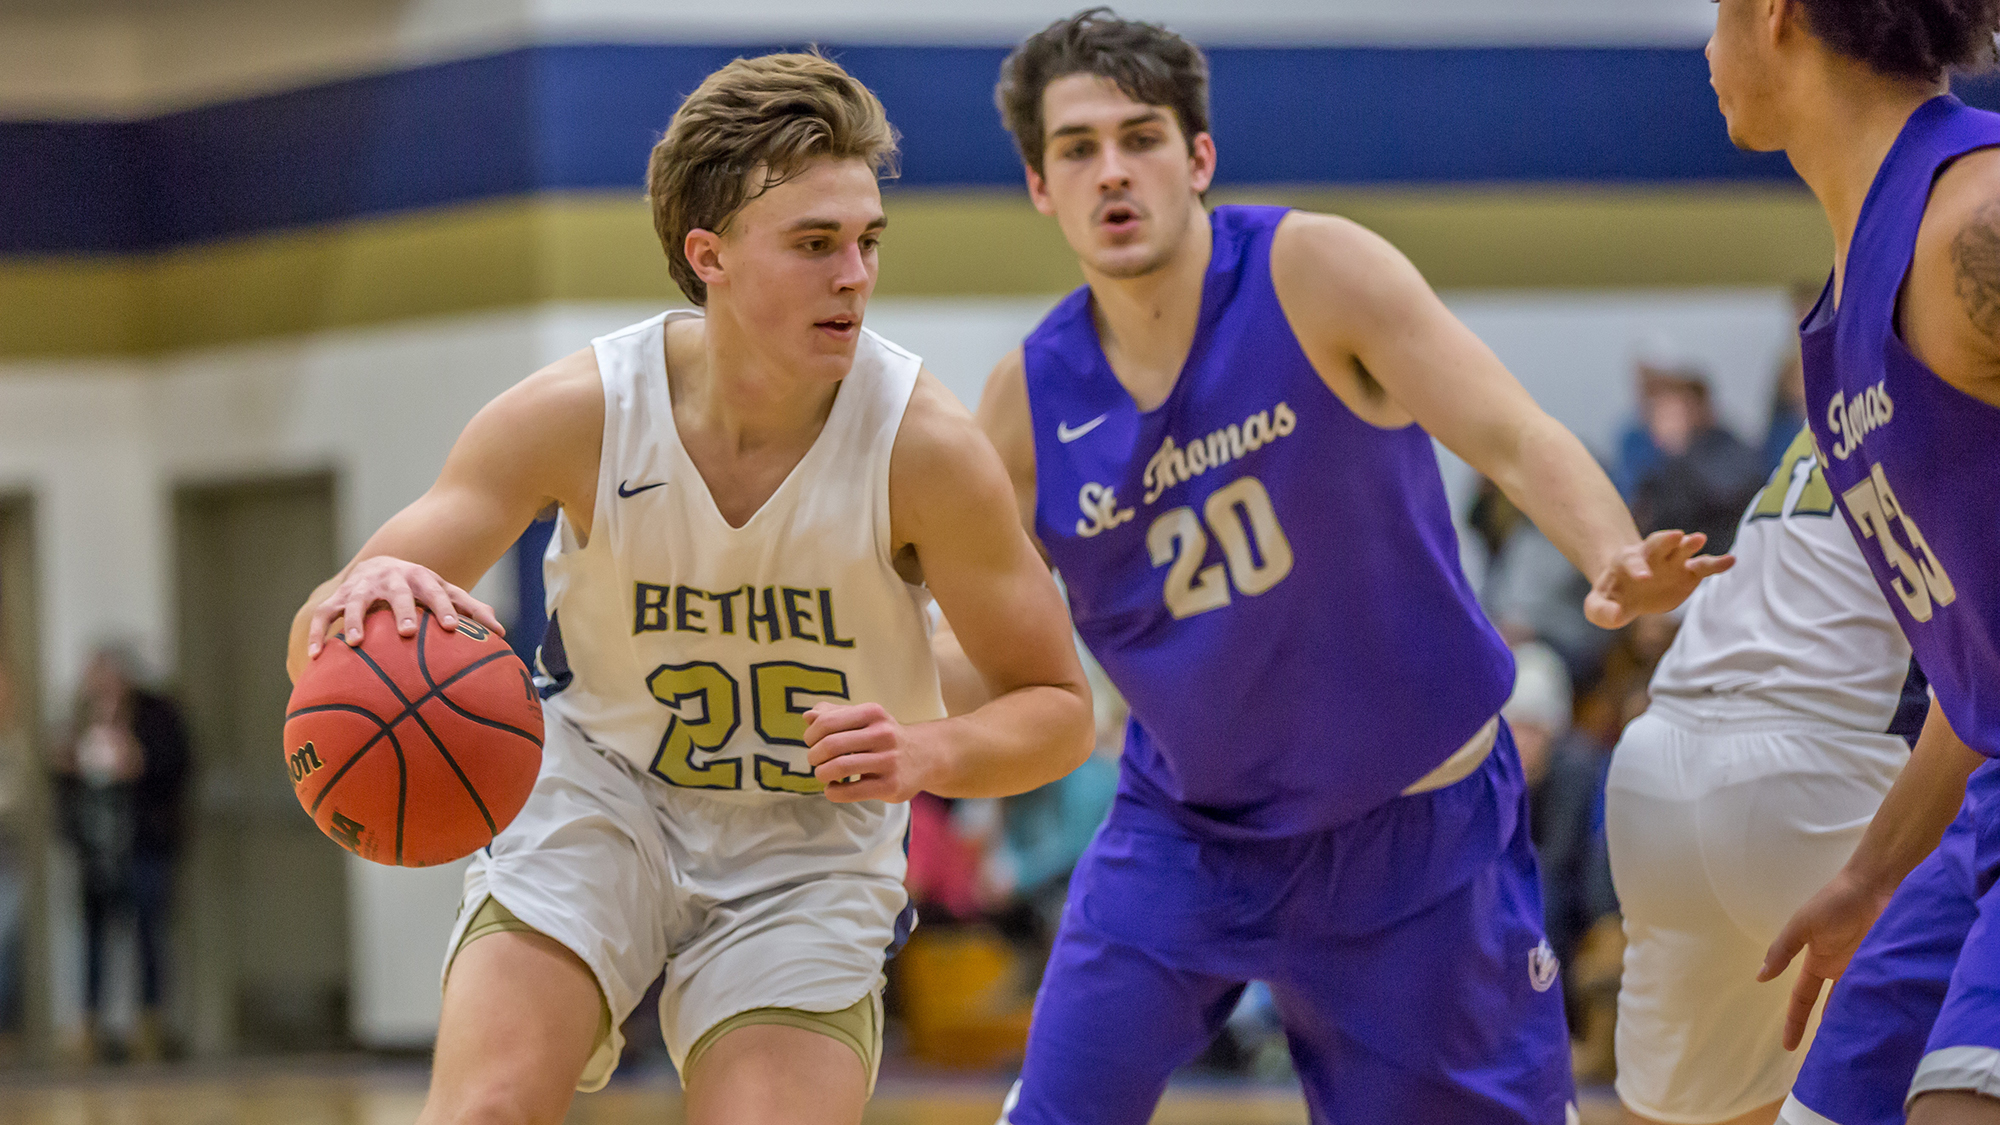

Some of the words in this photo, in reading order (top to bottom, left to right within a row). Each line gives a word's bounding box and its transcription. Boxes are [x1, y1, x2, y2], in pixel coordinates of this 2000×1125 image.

[1075, 482, 1136, 538] St.
[1143, 401, 1297, 505] Thomas
[1145, 475, 1295, 621] 20
[1841, 462, 1957, 624] 33
[632, 580, 857, 649] BETHEL
[645, 660, 852, 797] 25
